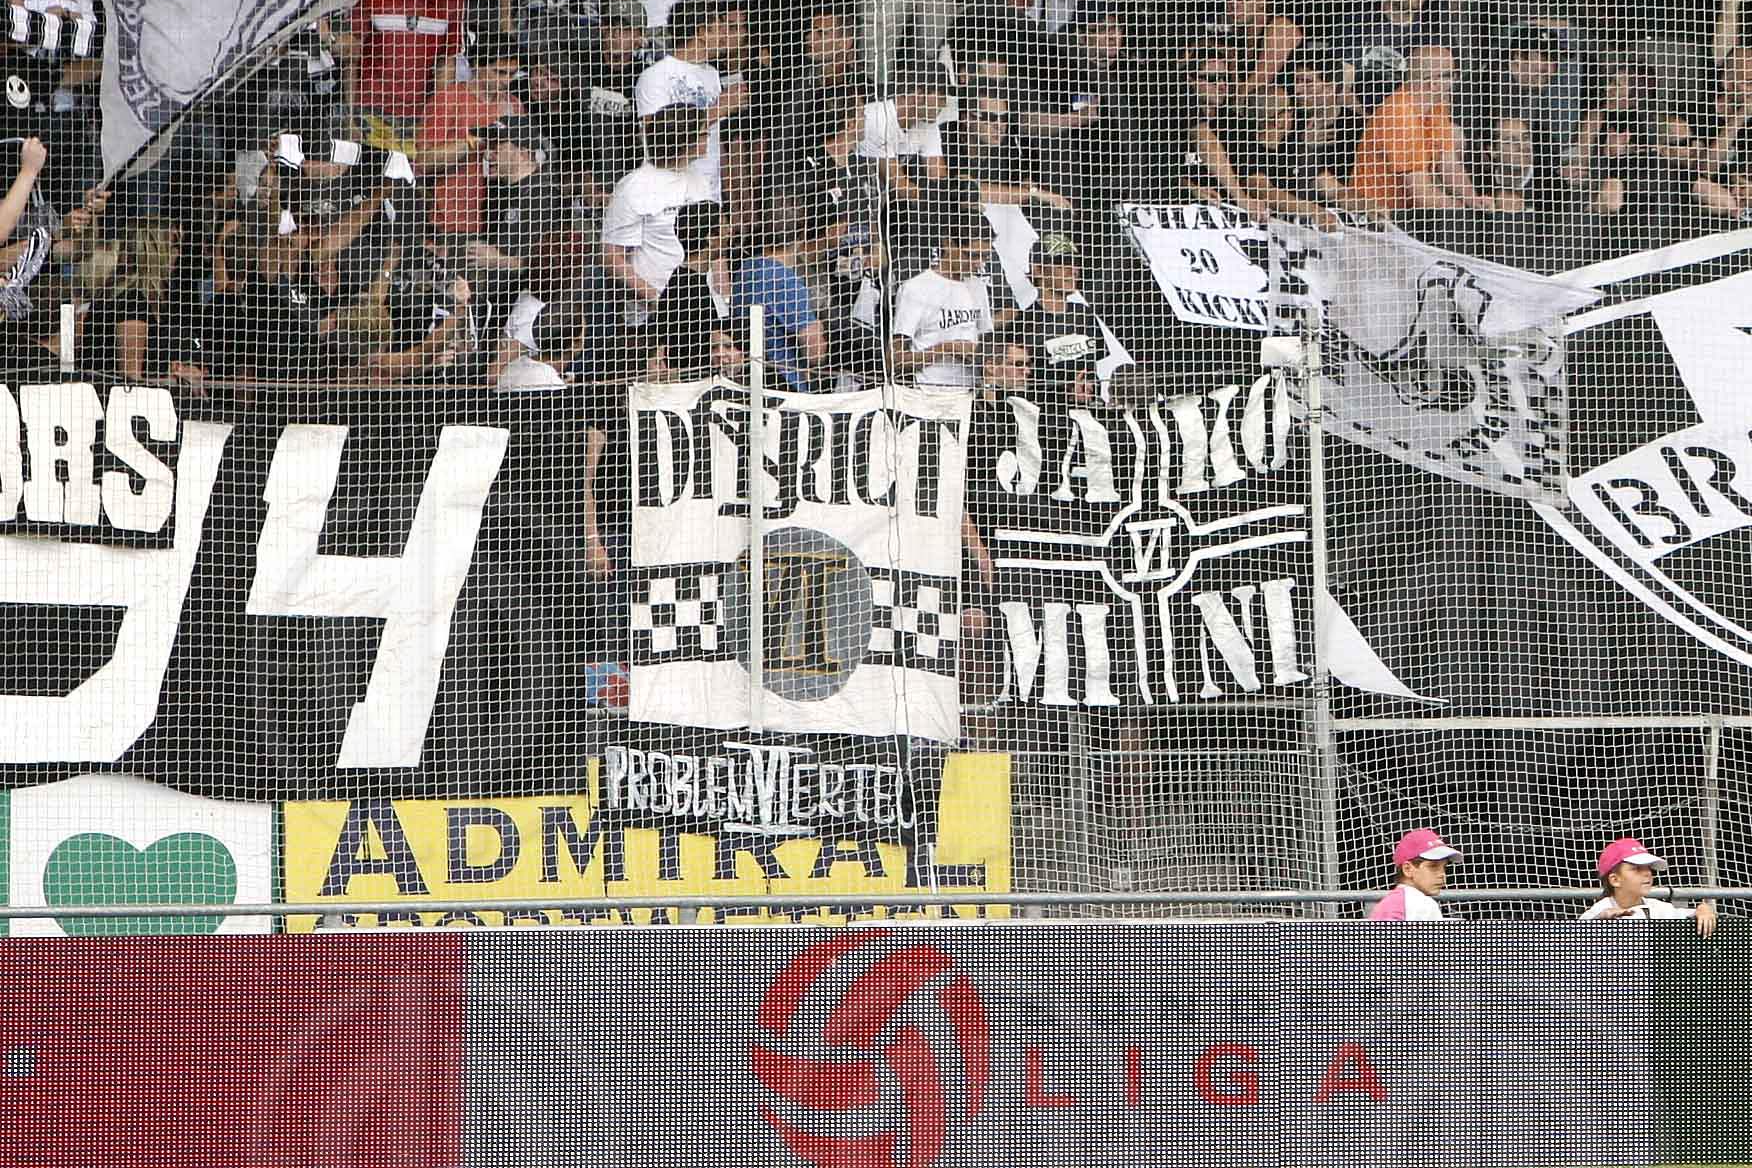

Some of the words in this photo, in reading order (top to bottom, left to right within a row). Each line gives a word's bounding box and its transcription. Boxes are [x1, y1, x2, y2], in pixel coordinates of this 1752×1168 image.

[1179, 247, 1221, 274] 20
[997, 577, 1313, 708] MINI
[1026, 1042, 1389, 1108] LIGA
